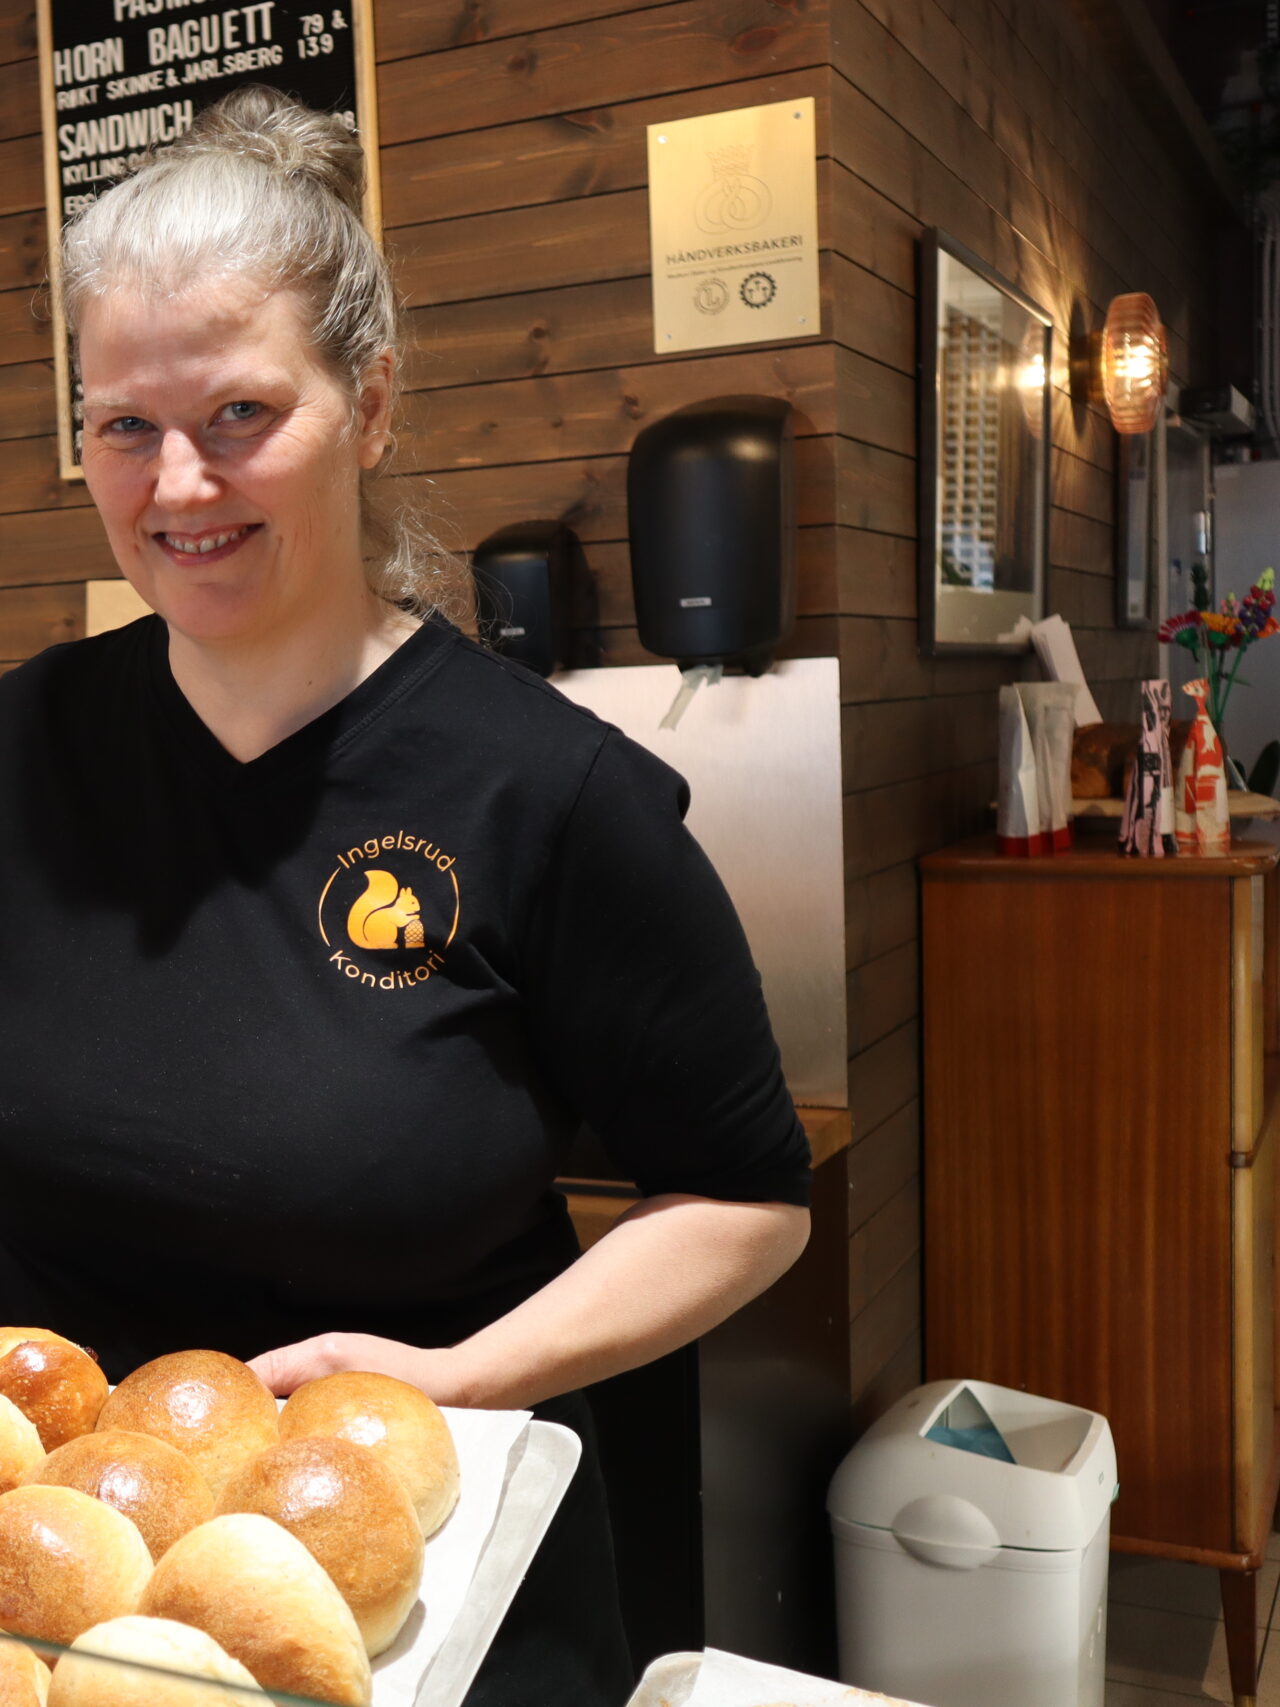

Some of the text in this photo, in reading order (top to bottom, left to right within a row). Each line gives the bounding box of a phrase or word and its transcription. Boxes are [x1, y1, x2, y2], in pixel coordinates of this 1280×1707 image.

[54, 37, 124, 86] HORN
[147, 2, 276, 66] BAGUETT
[299, 14, 325, 36] 79
[331, 9, 348, 30] &
[106, 69, 165, 100] SKINKE
[181, 44, 284, 84] JARLSBERG
[297, 33, 335, 59] 139
[58, 100, 194, 161] SANDWICH
[336, 830, 456, 872] Ingelsrud
[329, 950, 446, 990] Konditori
